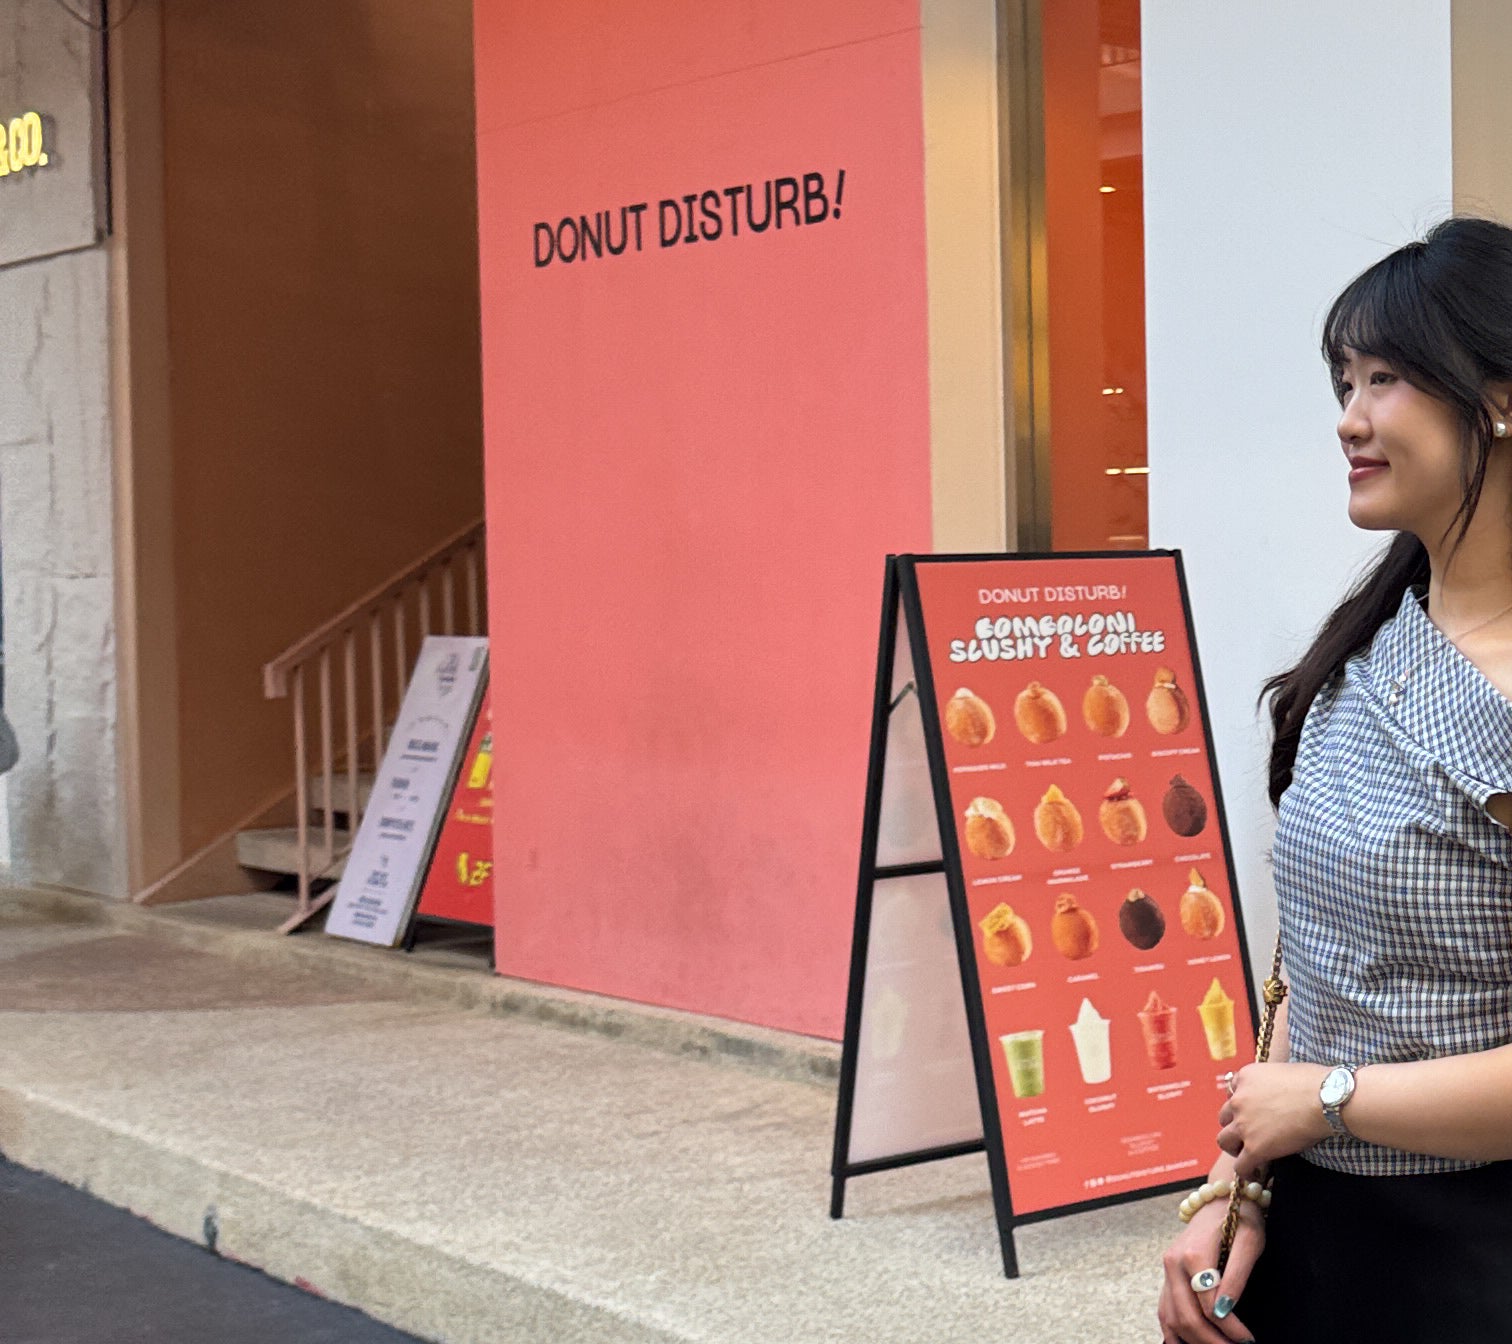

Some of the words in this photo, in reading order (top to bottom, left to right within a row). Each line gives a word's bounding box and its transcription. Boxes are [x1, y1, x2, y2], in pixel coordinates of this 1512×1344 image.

[533, 202, 647, 267] DONUT
[658, 168, 846, 248] DISTURB!
[978, 587, 1039, 604] DONUT
[1044, 585, 1127, 603] DISTURB!
[949, 636, 1053, 663] SLUSHY
[1059, 633, 1081, 658] &
[1087, 630, 1166, 657] COFFEE
